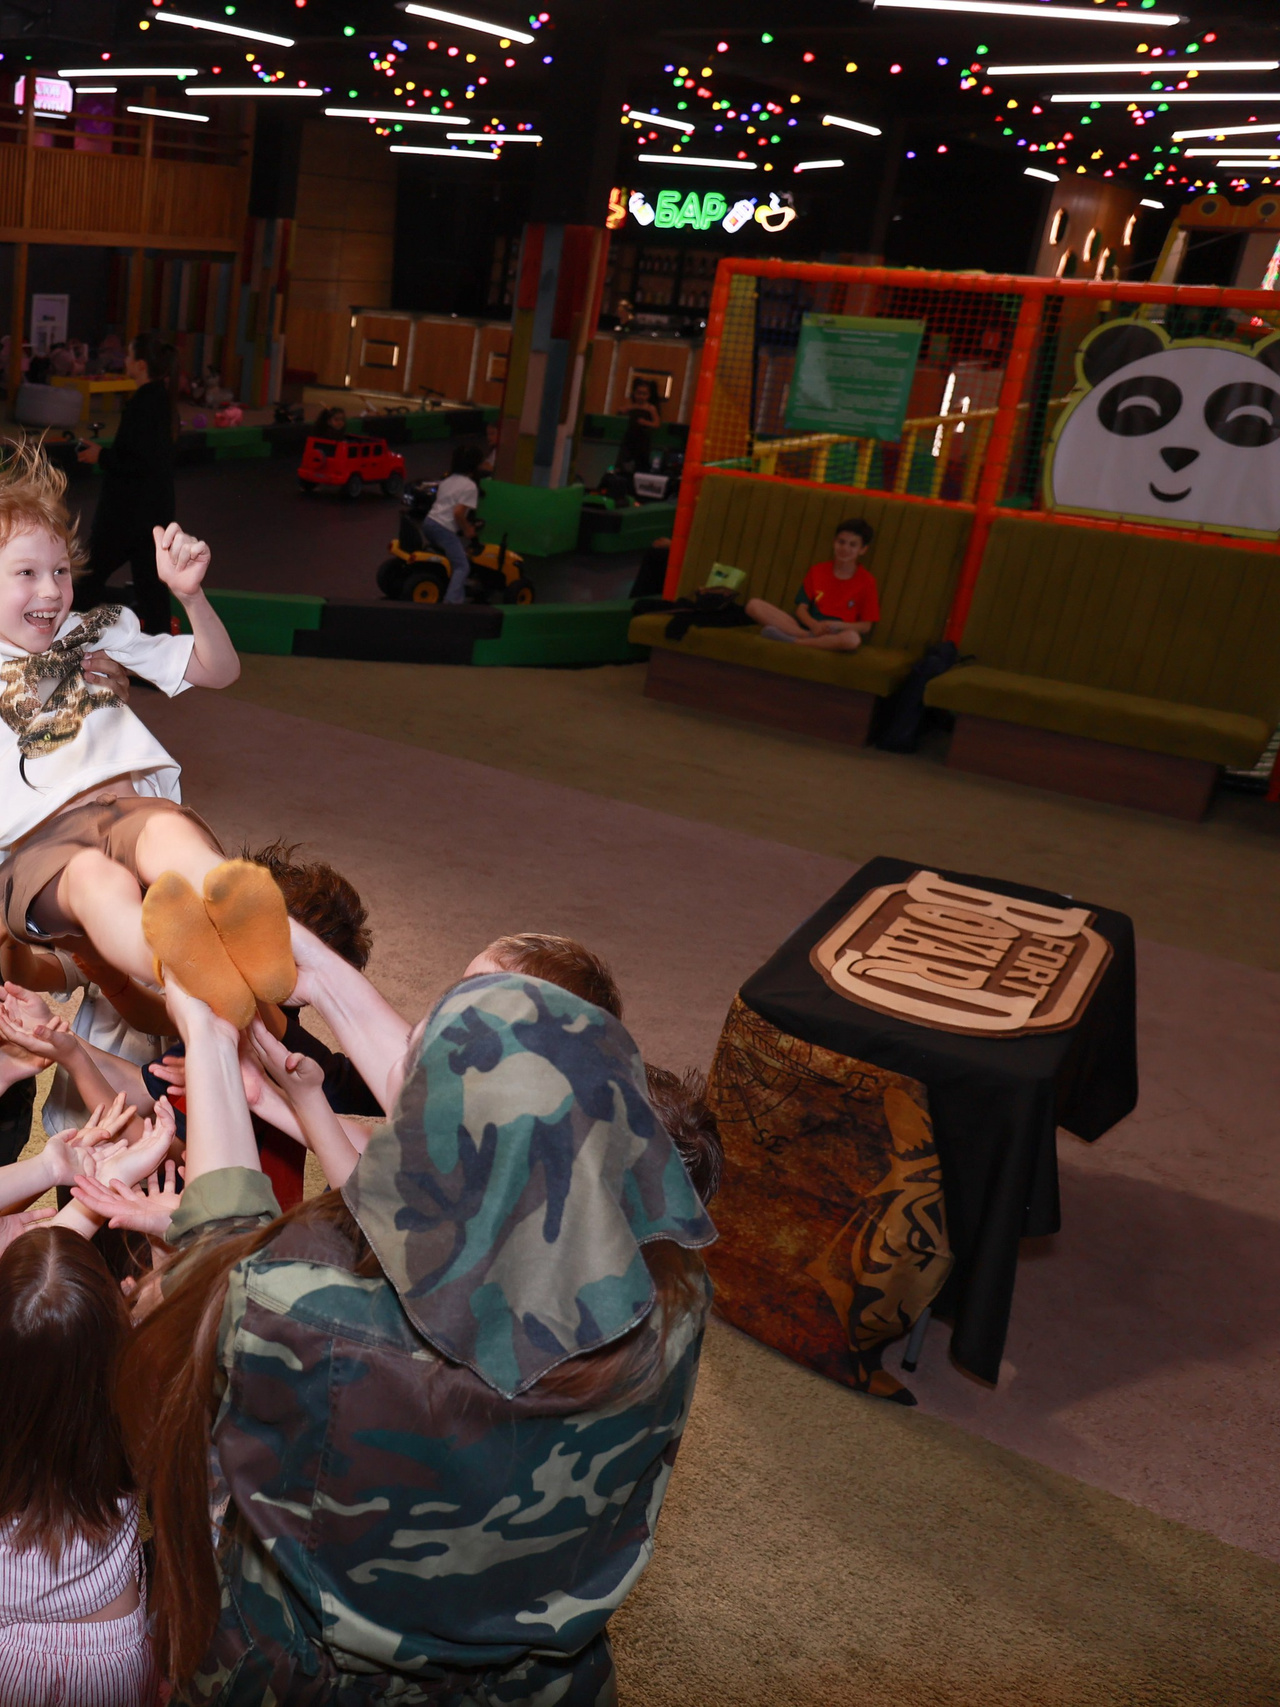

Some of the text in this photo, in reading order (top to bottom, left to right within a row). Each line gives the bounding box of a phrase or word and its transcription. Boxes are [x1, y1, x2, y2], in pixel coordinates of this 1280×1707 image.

[654, 190, 728, 231] БАР
[830, 869, 1093, 1031] BOYARD
[1000, 932, 1077, 1004] FORT
